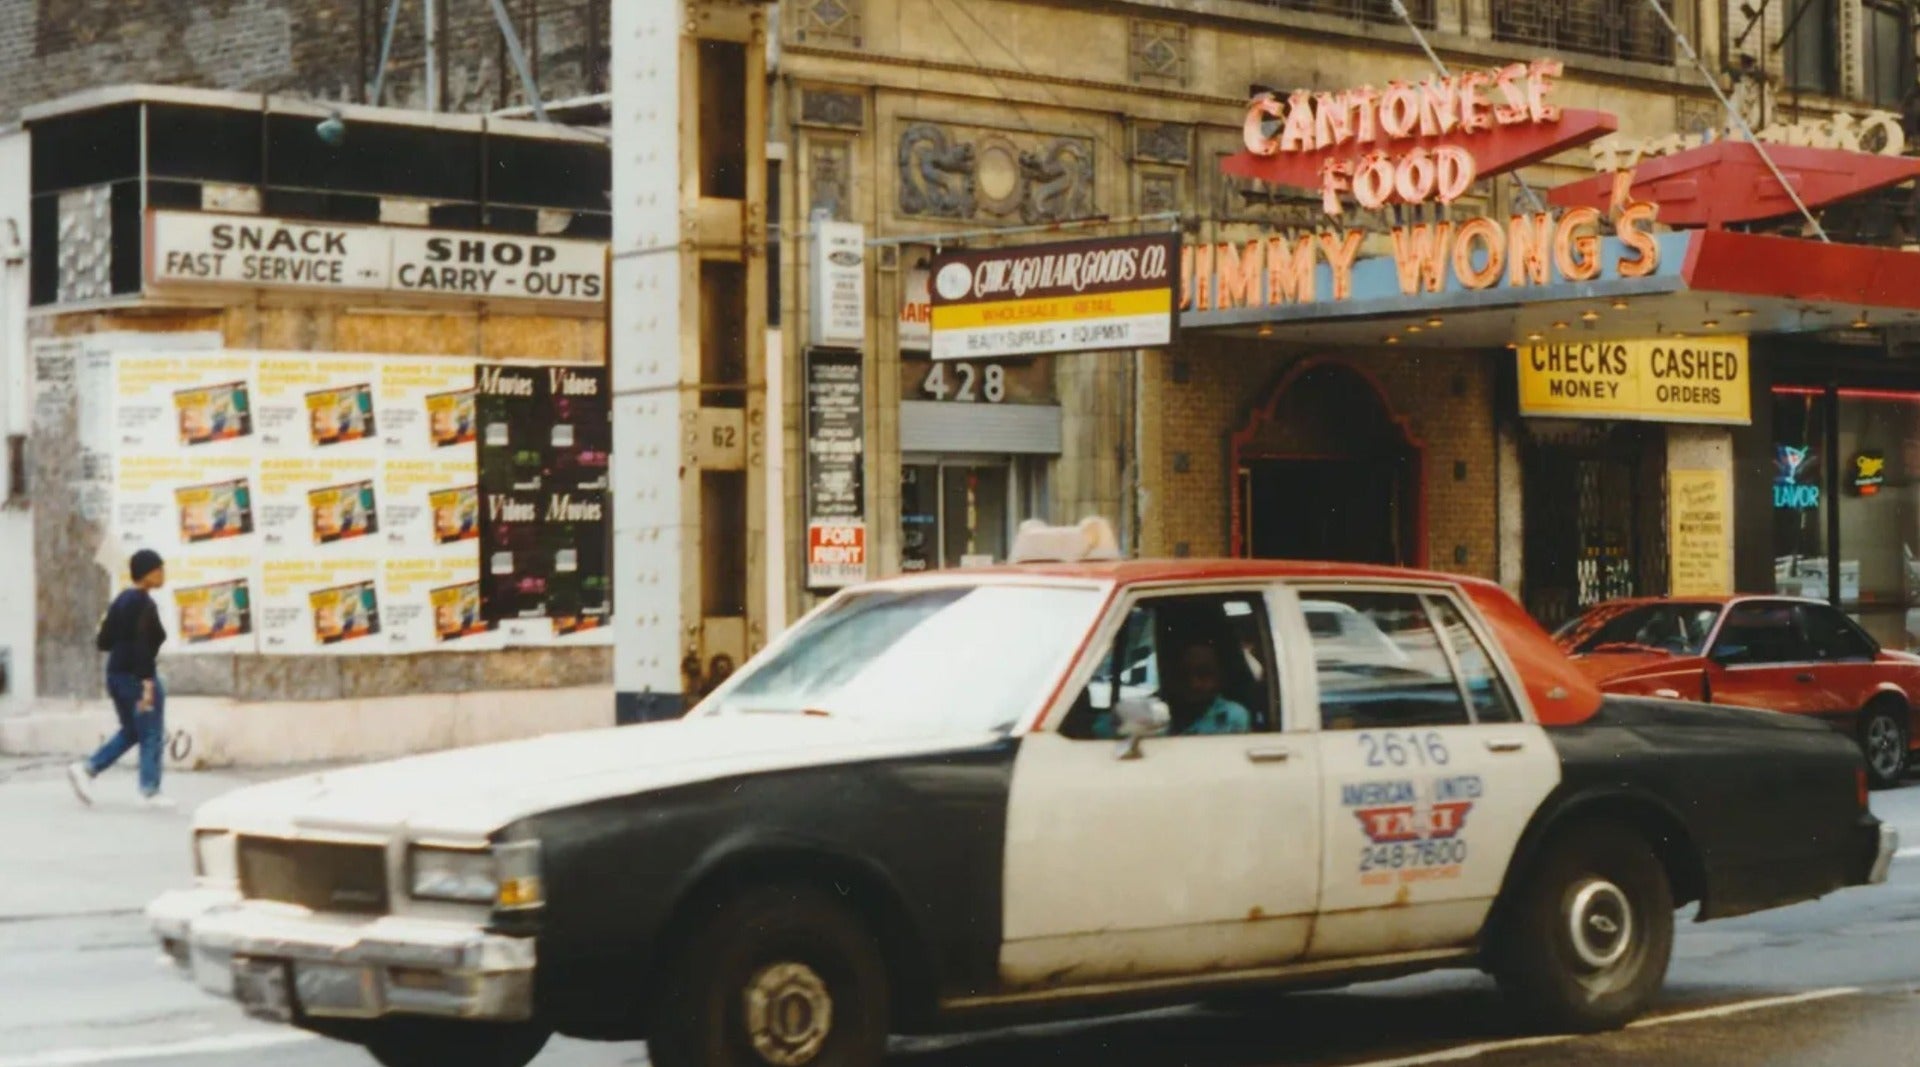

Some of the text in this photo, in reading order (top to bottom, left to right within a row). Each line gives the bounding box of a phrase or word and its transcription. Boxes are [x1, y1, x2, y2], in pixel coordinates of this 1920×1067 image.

[1243, 57, 1562, 156] CANTONESE
[1318, 145, 1477, 215] FOOD
[212, 224, 556, 267] SNACK SHOP
[1180, 169, 1658, 311] JIMMY WONG'S
[166, 251, 226, 277] FAST
[242, 255, 343, 283] SERVICE
[398, 263, 497, 292] CARRY
[523, 271, 600, 297] OUTS
[974, 244, 1167, 297] CHICAGO HAIR GOODS CO.
[900, 302, 932, 322] AIR
[1072, 323, 1129, 342] EQUIPMENT
[1531, 343, 1738, 381] CHECKS CASHED
[478, 367, 534, 396] Movies
[549, 367, 598, 395] Videos
[924, 362, 1005, 402] 428
[1550, 379, 1721, 404] MONEY ORDERS
[712, 426, 736, 447] 62
[488, 494, 602, 521] Videos Movies
[820, 527, 856, 545] FOR
[813, 546, 862, 564] RENT
[1358, 731, 1449, 766] 2616
[1341, 775, 1482, 806] AMERICAN UNITED
[1371, 807, 1454, 837] TAI
